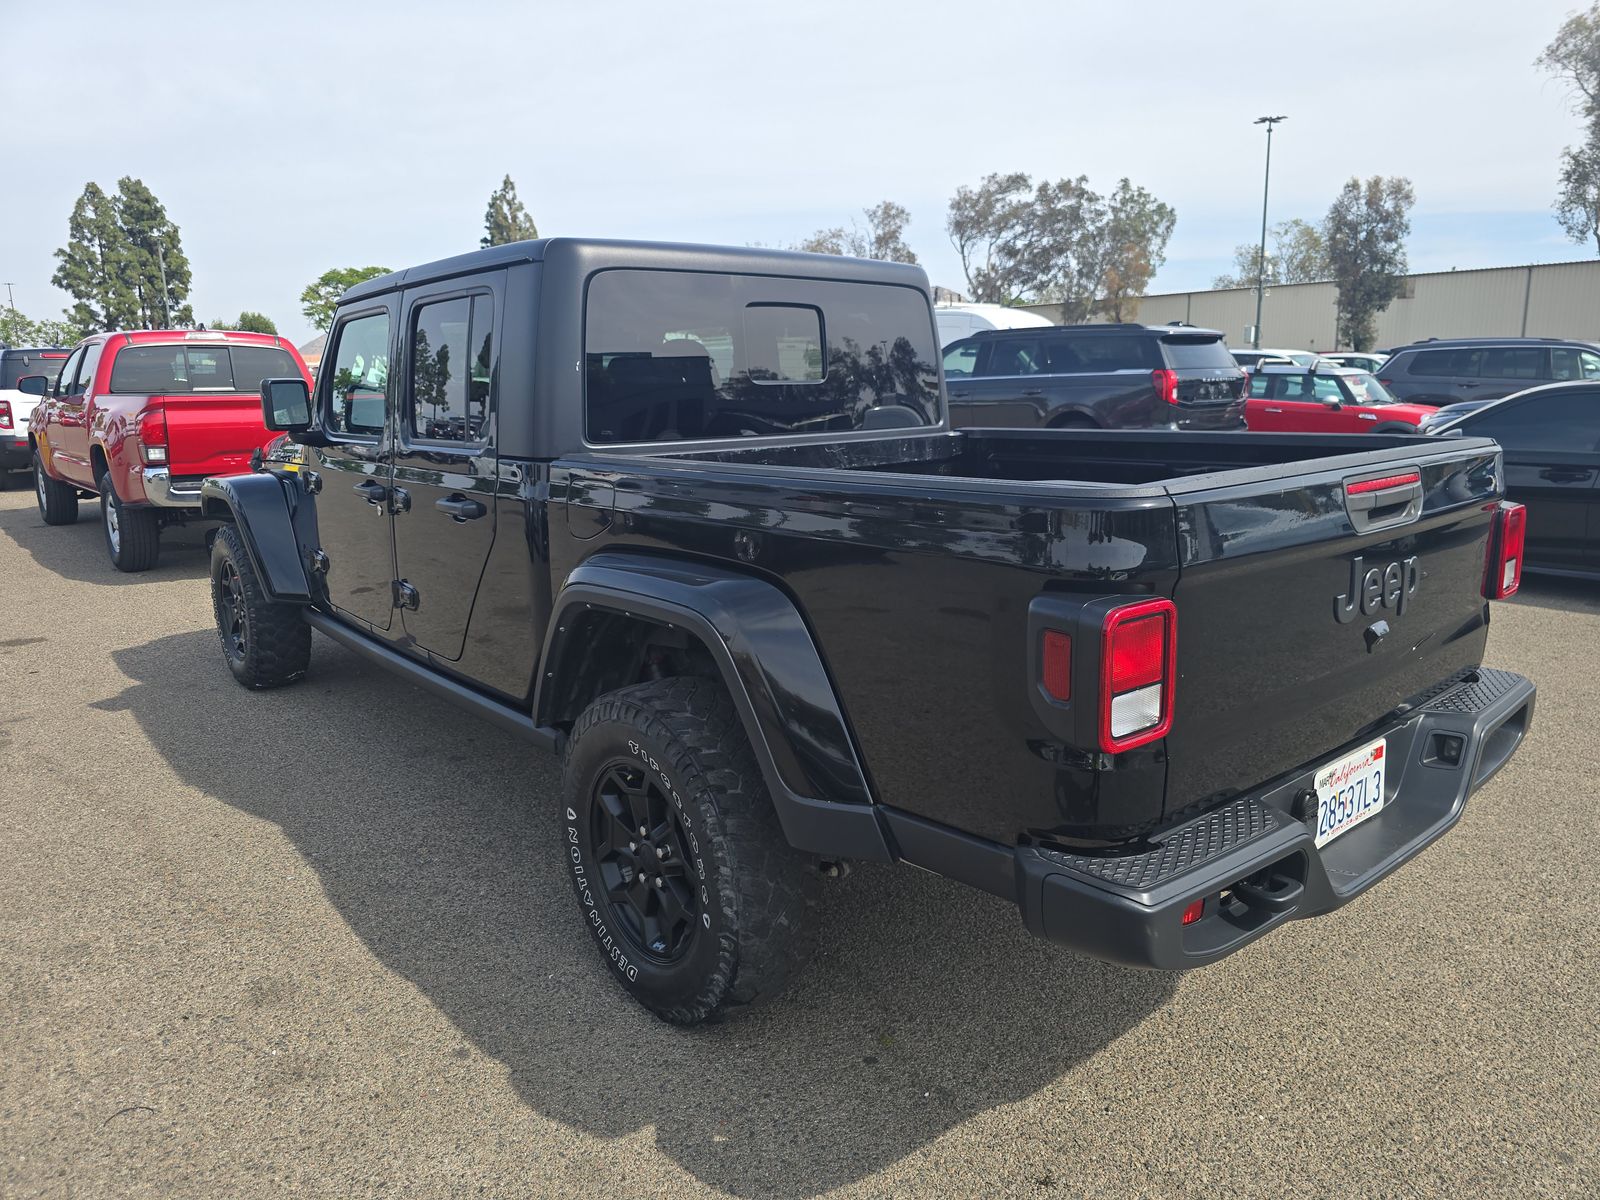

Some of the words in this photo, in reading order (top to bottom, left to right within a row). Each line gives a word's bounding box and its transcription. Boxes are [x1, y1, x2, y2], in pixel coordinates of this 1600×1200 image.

[1333, 555, 1420, 624] Jeep
[1319, 770, 1381, 837] 28537L3
[1329, 758, 1373, 787] California
[567, 826, 639, 983] DESTINATION
